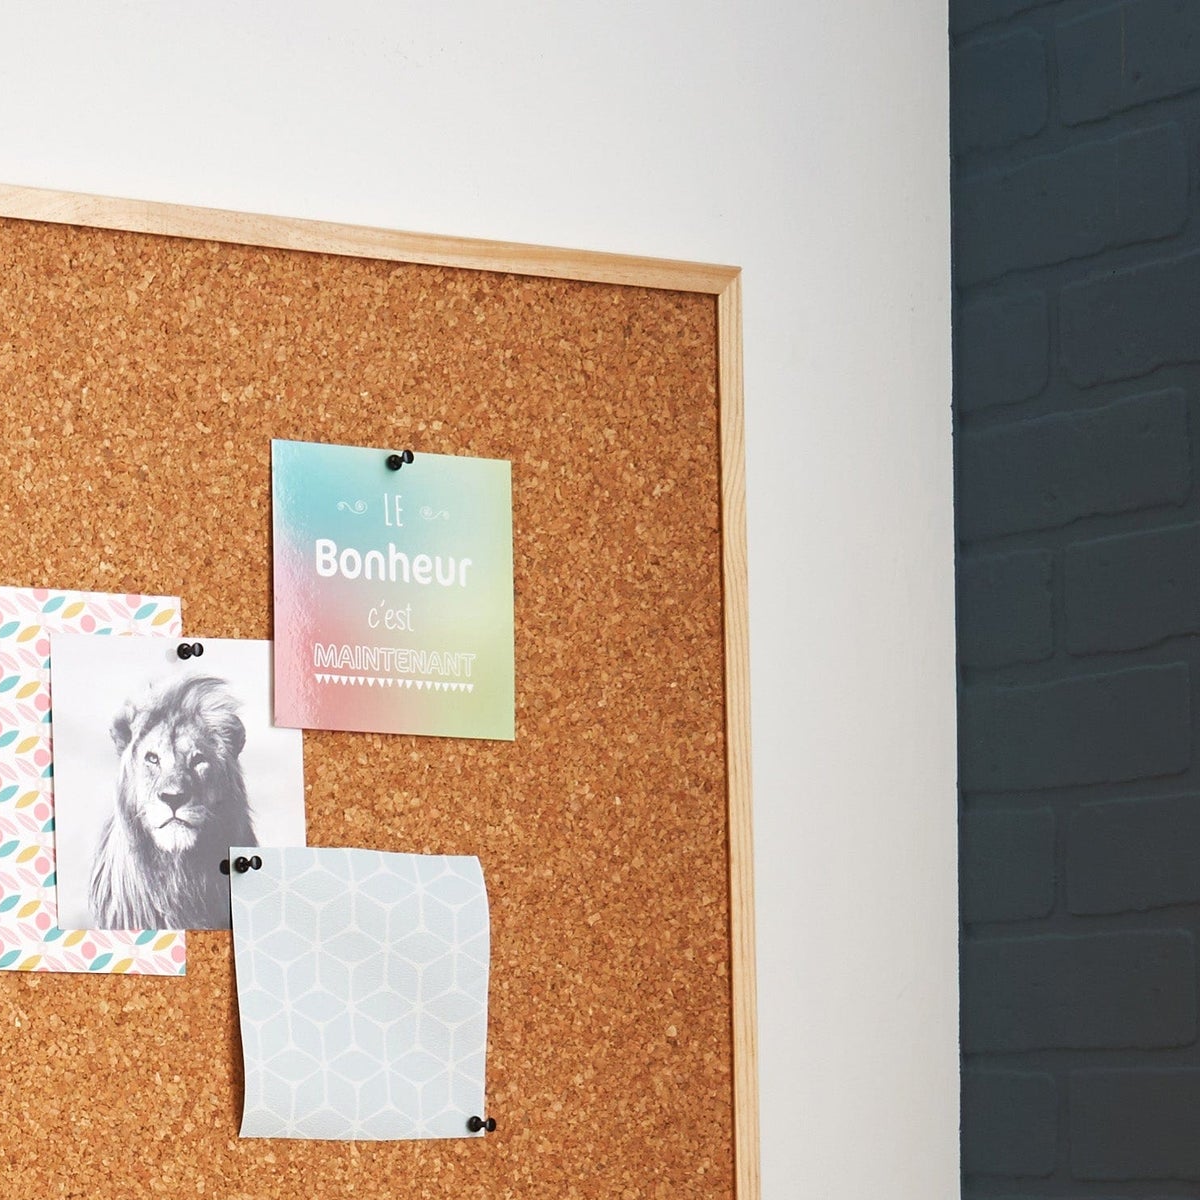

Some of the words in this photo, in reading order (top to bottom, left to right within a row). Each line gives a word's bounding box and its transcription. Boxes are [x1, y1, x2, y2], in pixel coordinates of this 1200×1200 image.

[384, 493, 404, 527] LE
[315, 538, 472, 587] Bonheur
[367, 599, 414, 631] c'est
[314, 643, 476, 677] MAINTENANT
